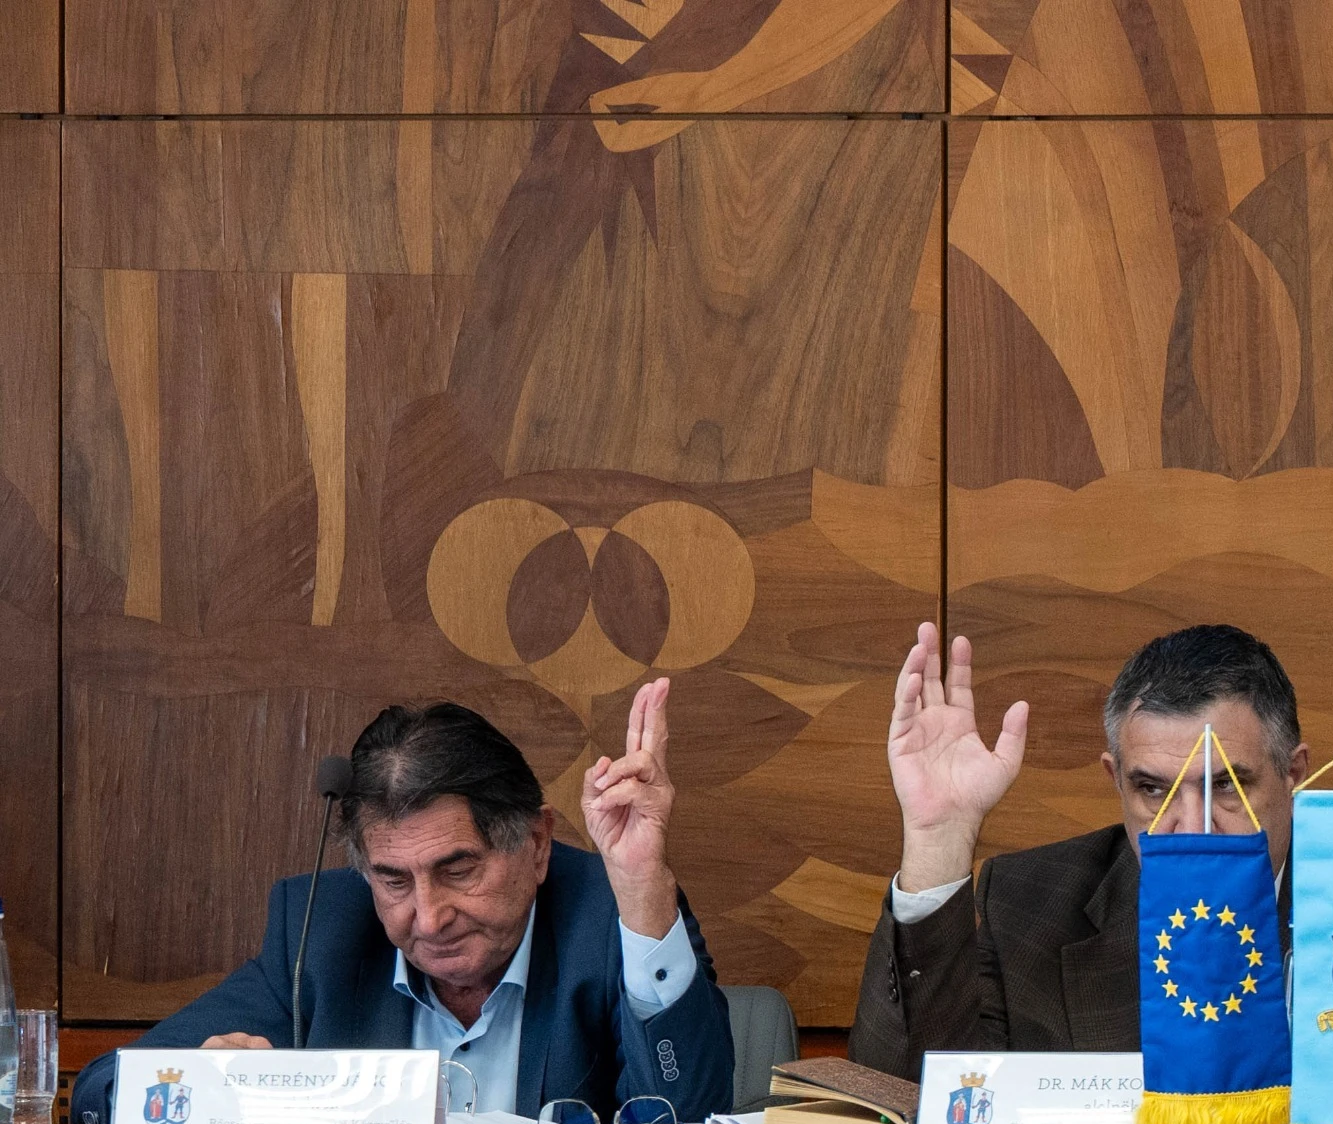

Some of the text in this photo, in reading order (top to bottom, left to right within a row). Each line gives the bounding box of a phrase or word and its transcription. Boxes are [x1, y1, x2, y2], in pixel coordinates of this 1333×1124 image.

[223, 1073, 252, 1087] DR.
[1038, 1077, 1065, 1091] DR.
[1071, 1075, 1113, 1091] MÁK
